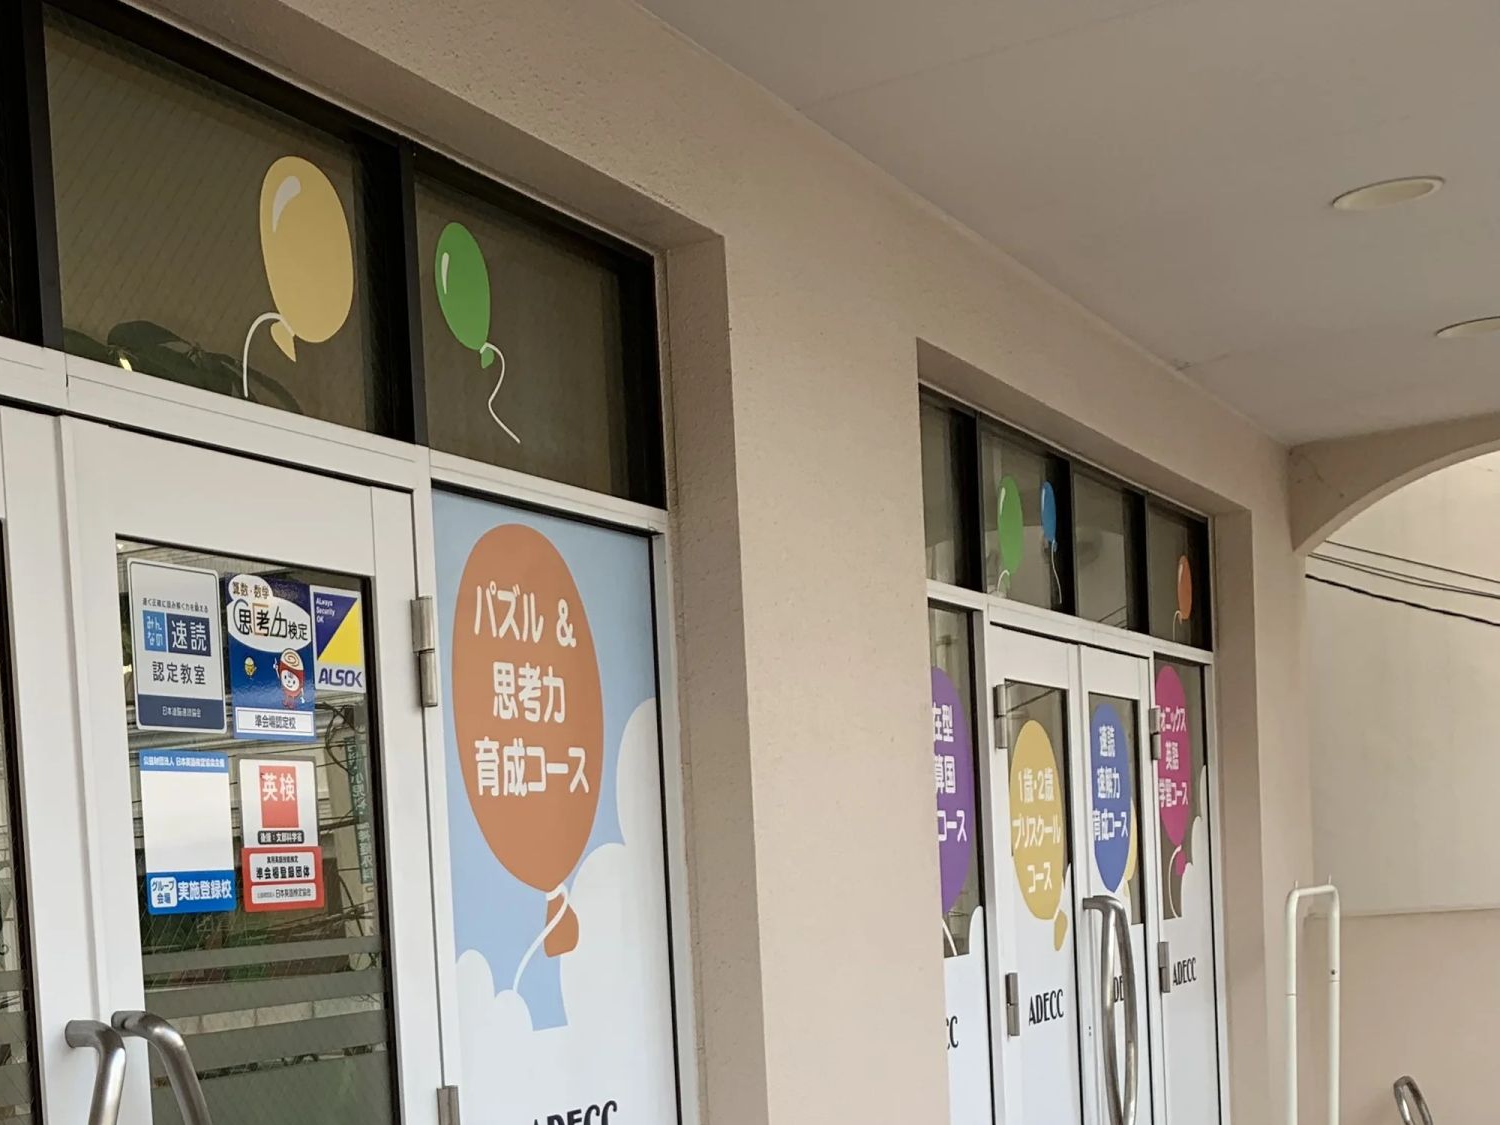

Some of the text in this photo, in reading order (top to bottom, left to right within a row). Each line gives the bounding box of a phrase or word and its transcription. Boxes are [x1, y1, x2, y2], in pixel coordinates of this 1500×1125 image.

[316, 607, 336, 617] Security
[316, 616, 325, 624] OK
[473, 584, 577, 648] パズル &
[171, 620, 207, 651] 速読
[152, 661, 206, 685] 認定教室
[318, 668, 363, 688] ALSOK
[492, 661, 566, 725] 思考力
[474, 735, 590, 797] 育成コース
[262, 772, 295, 801] 英検
[152, 879, 174, 892] グループ
[178, 879, 232, 902] 実施登録校
[1028, 862, 1053, 894] コース
[1172, 957, 1197, 986] ADECC
[1028, 988, 1065, 1026] ADECC
